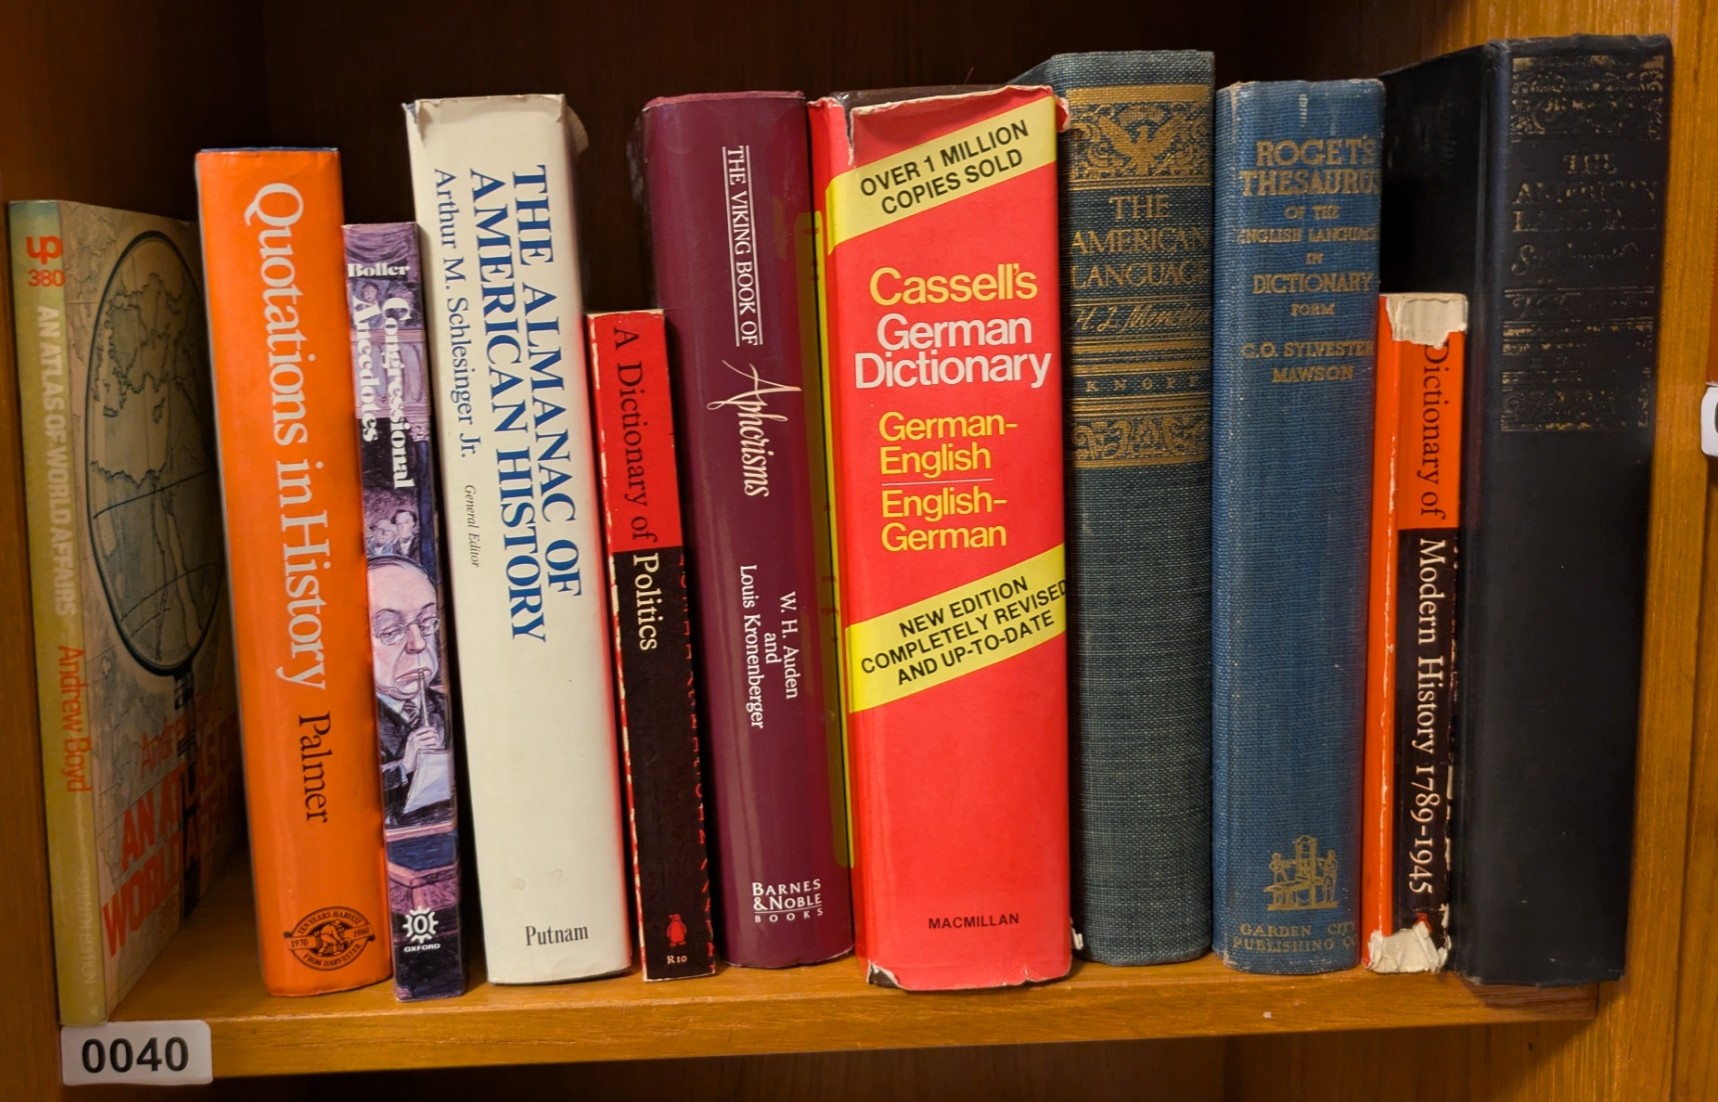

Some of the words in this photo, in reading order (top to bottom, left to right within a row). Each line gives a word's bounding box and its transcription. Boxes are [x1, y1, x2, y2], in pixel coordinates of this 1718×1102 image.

[727, 145, 746, 184] THE
[860, 161, 921, 196] OVER
[924, 155, 935, 173] 1
[940, 119, 1029, 167] MILLION
[881, 171, 961, 215] COPIES
[965, 148, 1023, 184] SOLD
[434, 168, 460, 249] Arthur
[513, 164, 554, 266] THE
[730, 190, 752, 255] VIKING
[1109, 194, 1170, 220] THE
[1284, 206, 1306, 220] OF
[1312, 204, 1340, 220] THE
[27, 269, 66, 288] 380
[348, 263, 410, 278] Boller
[443, 256, 467, 290] M.
[1306, 252, 1324, 266] IN
[470, 168, 529, 433] AMERICAN
[736, 260, 756, 316] BOOK
[869, 263, 1039, 306] Cassell's
[1252, 272, 1374, 294] DICTIONARY
[37, 305, 60, 339] AN
[244, 182, 316, 446] Quotations
[1290, 303, 1335, 316] FORM
[614, 326, 640, 350] A
[740, 320, 758, 346] OF
[877, 313, 1032, 351] German
[39, 341, 65, 411] ATLAS
[352, 295, 381, 442] Anecdotes
[447, 297, 476, 426] Schlesinger
[854, 350, 1052, 389] Dictionary
[1272, 365, 1354, 383] MAWSON
[381, 297, 415, 489] Congressional
[522, 281, 577, 523] ALMANAC
[42, 412, 67, 448] OF
[459, 432, 481, 458] Jr.
[617, 361, 648, 507] Dictionary
[706, 359, 803, 498] Aphorisms
[879, 411, 1018, 441] German-
[880, 442, 991, 479] English
[45, 450, 71, 522] WORLD
[276, 460, 324, 508] in
[882, 485, 1008, 522] English-
[464, 484, 480, 528] General
[1421, 495, 1446, 520] of
[469, 533, 481, 568] Editor
[496, 446, 546, 643] HISTORY
[632, 521, 658, 543] of
[881, 523, 1007, 552] German
[49, 523, 77, 617] AFFAIRS
[545, 539, 582, 597] OF
[739, 564, 760, 608] Louis
[276, 510, 331, 690] History
[633, 552, 664, 650] Politics
[779, 590, 797, 612] W.
[898, 607, 944, 638] NEW
[948, 576, 1028, 619] EDITION
[1418, 538, 1446, 645] Modern
[764, 632, 780, 664] and
[781, 618, 797, 639] H.
[860, 613, 988, 674] COMPLETELY
[897, 656, 938, 686] AND
[943, 610, 1055, 669] UP-TO-DATE
[58, 644, 88, 733] Andrew
[743, 613, 764, 729] Kronenberger
[782, 645, 800, 699] Auden
[1411, 656, 1444, 754] History
[61, 736, 92, 793] Boyd
[298, 710, 333, 824] Palmer
[121, 790, 156, 872] AN
[1408, 764, 1440, 894] 1789-1945
[752, 878, 822, 896] BARNES
[525, 925, 589, 946] Putnam
[754, 907, 823, 923] BOOKS
[928, 913, 1020, 929] MACMILLAN
[1240, 923, 1312, 938] GARDEN
[404, 943, 441, 952] OXFORD
[1232, 936, 1335, 953] PUBLISHING
[81, 1036, 189, 1075] 0040
